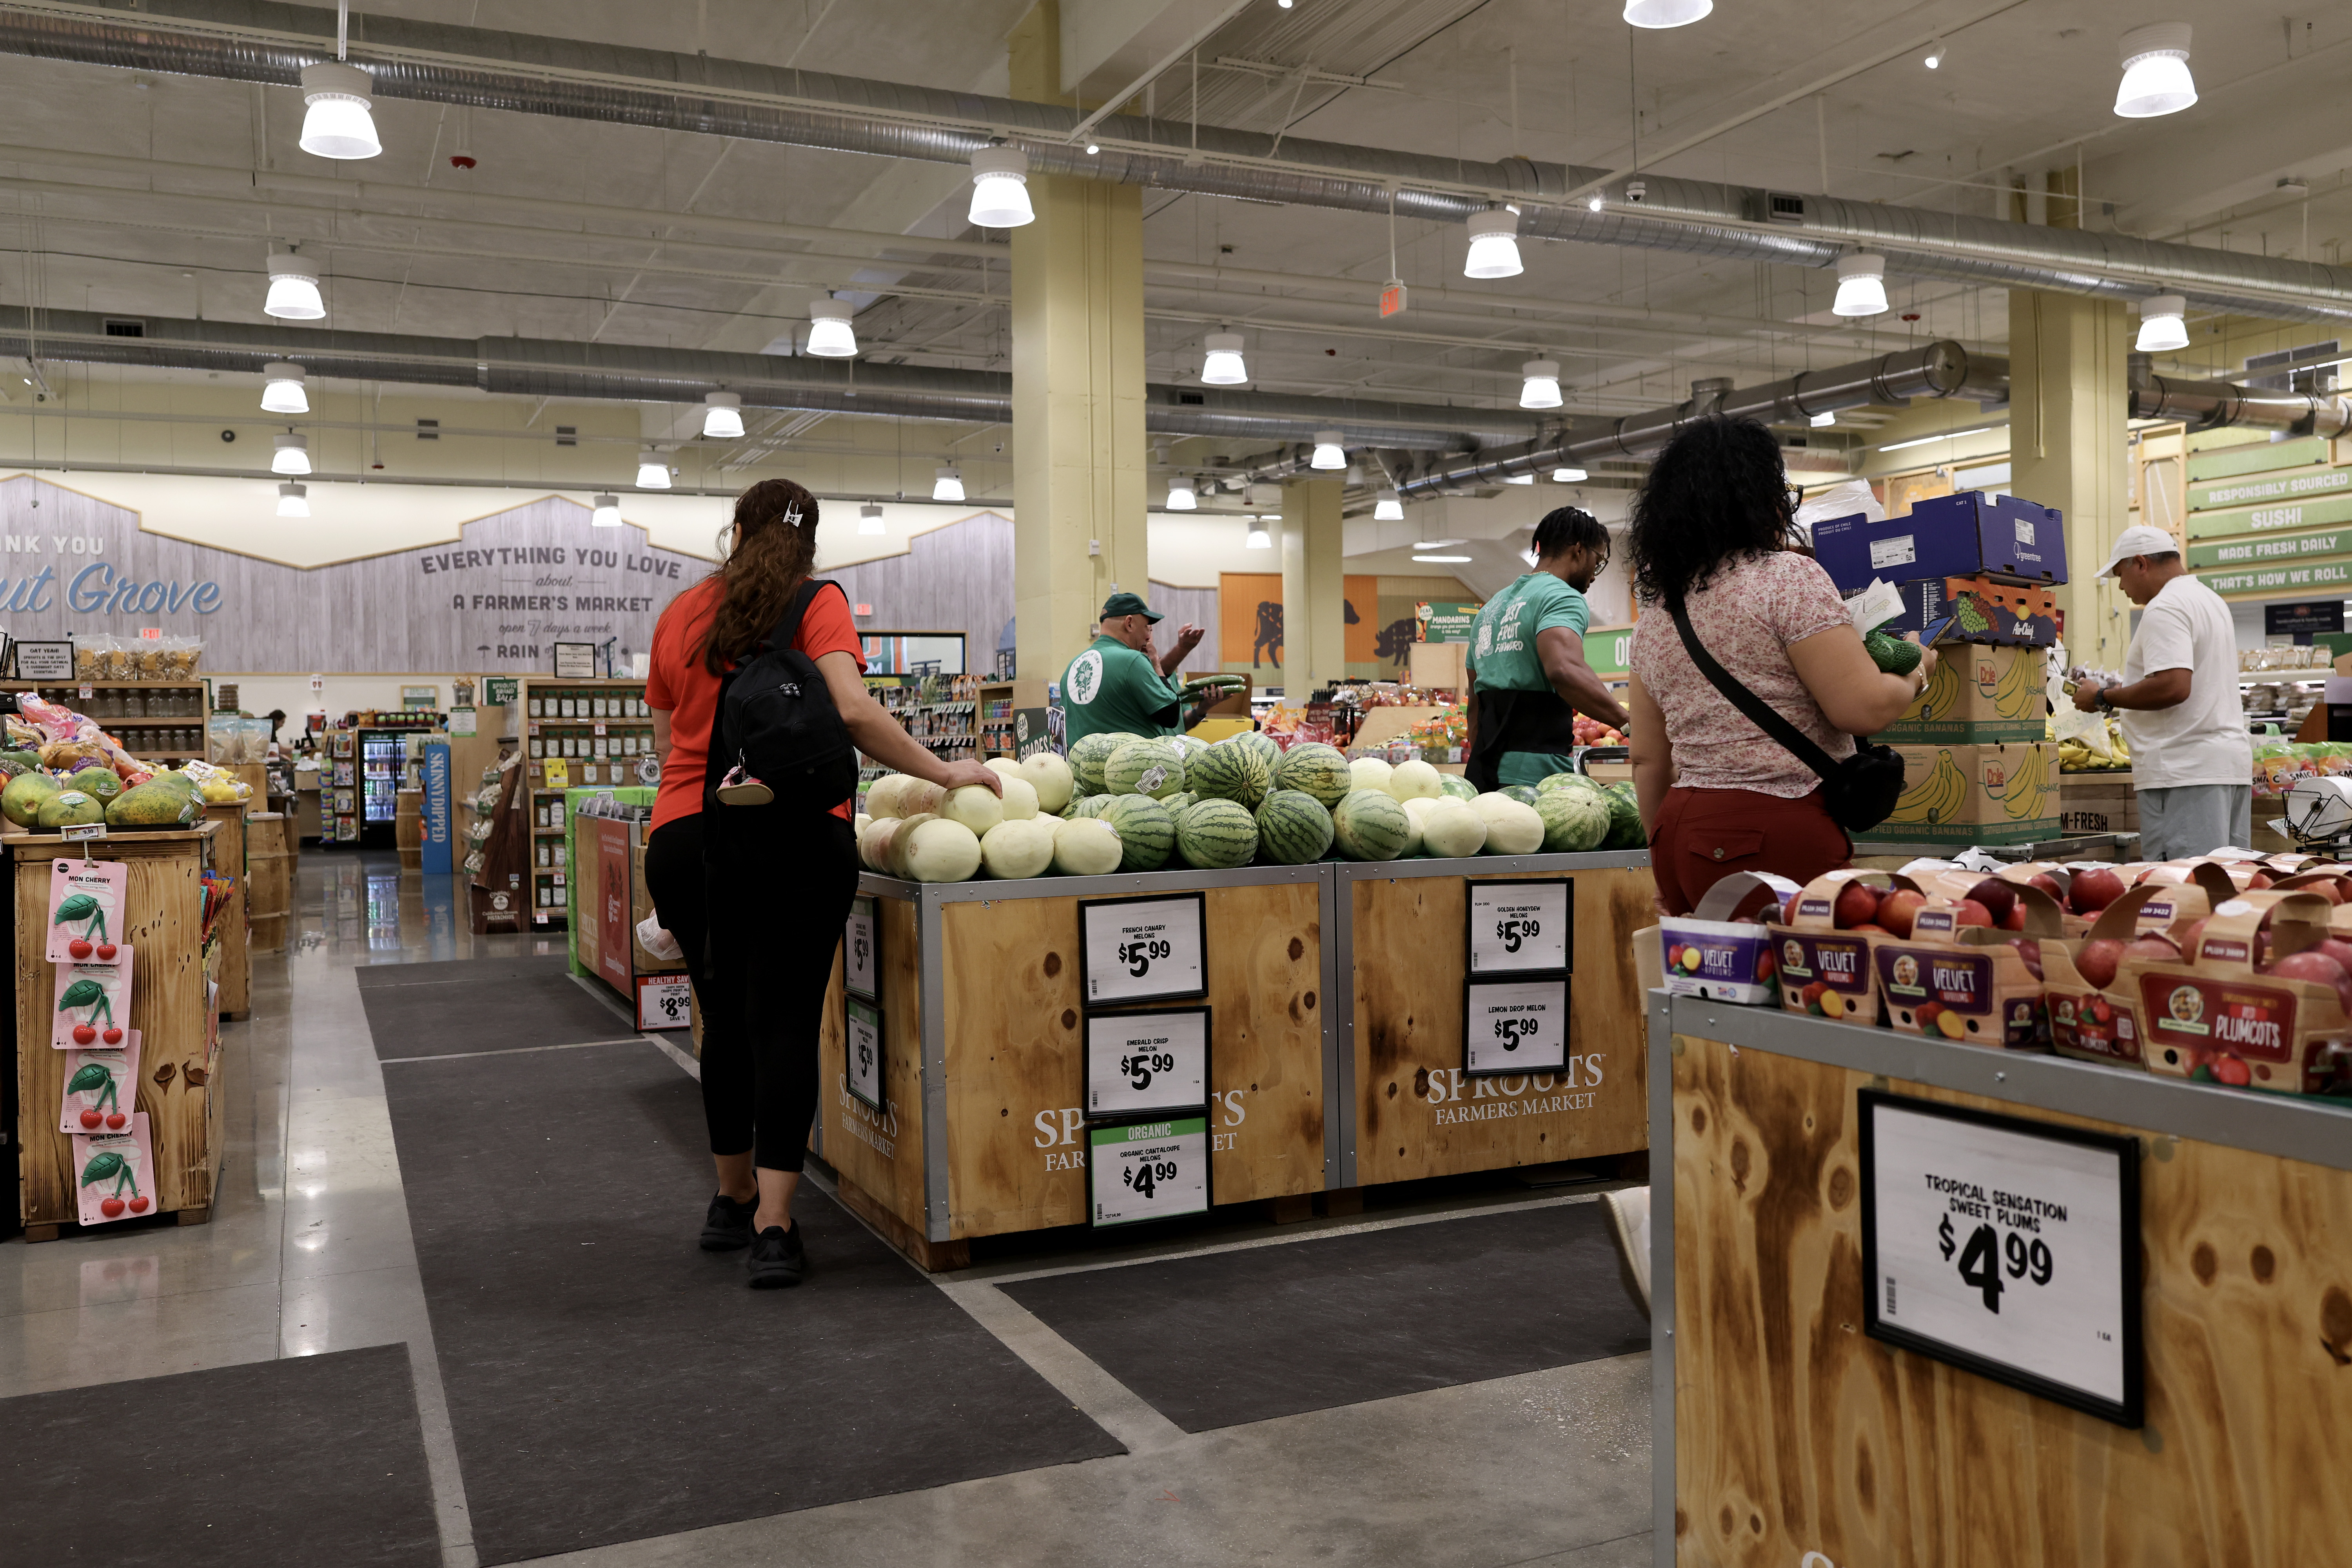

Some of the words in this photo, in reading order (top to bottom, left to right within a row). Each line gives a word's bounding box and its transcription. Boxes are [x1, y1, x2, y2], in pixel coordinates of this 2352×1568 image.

[1383, 288, 1399, 316] EXIT
[2209, 481, 2287, 503] RESPONSIBLY
[2290, 472, 2348, 492] SOURCED
[2251, 507, 2303, 529] SUSHI
[53, 536, 105, 555] YOU
[2218, 545, 2252, 561] MADE
[2256, 541, 2297, 557] FRESH
[2301, 536, 2337, 552] DAILY
[421, 548, 566, 574] EVERYTHING
[576, 549, 617, 568] YOU
[627, 554, 681, 579] LOVE
[2020, 552, 2042, 563] greentree
[536, 574, 573, 587] about
[2211, 575, 2254, 590] THAT'S
[2258, 572, 2287, 586] HOW
[2290, 570, 2310, 583] WE
[2314, 566, 2348, 581] ROLL
[67, 563, 223, 615] Grove
[453, 595, 465, 610] A
[473, 595, 568, 610] FARMER'S
[576, 597, 653, 612] MARKET
[499, 622, 525, 635] open
[528, 619, 542, 637] 7
[543, 621, 570, 638] days
[573, 624, 581, 634] a
[584, 622, 612, 634] week
[1432, 615, 1470, 624] MANDARINS
[143, 628, 160, 639] EXIT
[1497, 622, 1521, 641] FRUIT
[497, 645, 539, 658] RAIN
[1980, 666, 1996, 683] Dole
[1017, 717, 1027, 730] PEAK
[1924, 724, 1964, 732] BANANAS
[1018, 728, 1029, 741] SEASON
[1020, 734, 1049, 763] GRAPES
[1987, 768, 2004, 785] Dole
[430, 752, 446, 843] SKINNYDIPPED
[2036, 783, 2060, 795] ORGANIC
[1894, 826, 1929, 835] ORGANIC
[1932, 826, 1973, 836] BANANAS
[1704, 949, 1734, 968] VELVET
[2204, 944, 2224, 956] PLU#
[1817, 949, 1856, 973] VELVET
[648, 976, 675, 985] HEALTHY
[1933, 967, 1975, 992] VELVET
[2215, 1014, 2281, 1049] PLUMCOTS
[1435, 1101, 1517, 1125] FARMERS
[1522, 1092, 1596, 1116] MARKET
[107, 1131, 132, 1140] CHERRY
[842, 1112, 867, 1142] FARMERS
[869, 1129, 895, 1160] MARKET
[1128, 1123, 1171, 1140] ORGANIC
[1145, 1145, 1180, 1154] CANTALOUPE
[1925, 1174, 1987, 1202] TROPICAL
[1992, 1189, 2067, 1222] SENSATION
[1949, 1197, 1991, 1220] SWEET
[1997, 1209, 2041, 1233] PLUMS
[2102, 1332, 2112, 1342] EA
